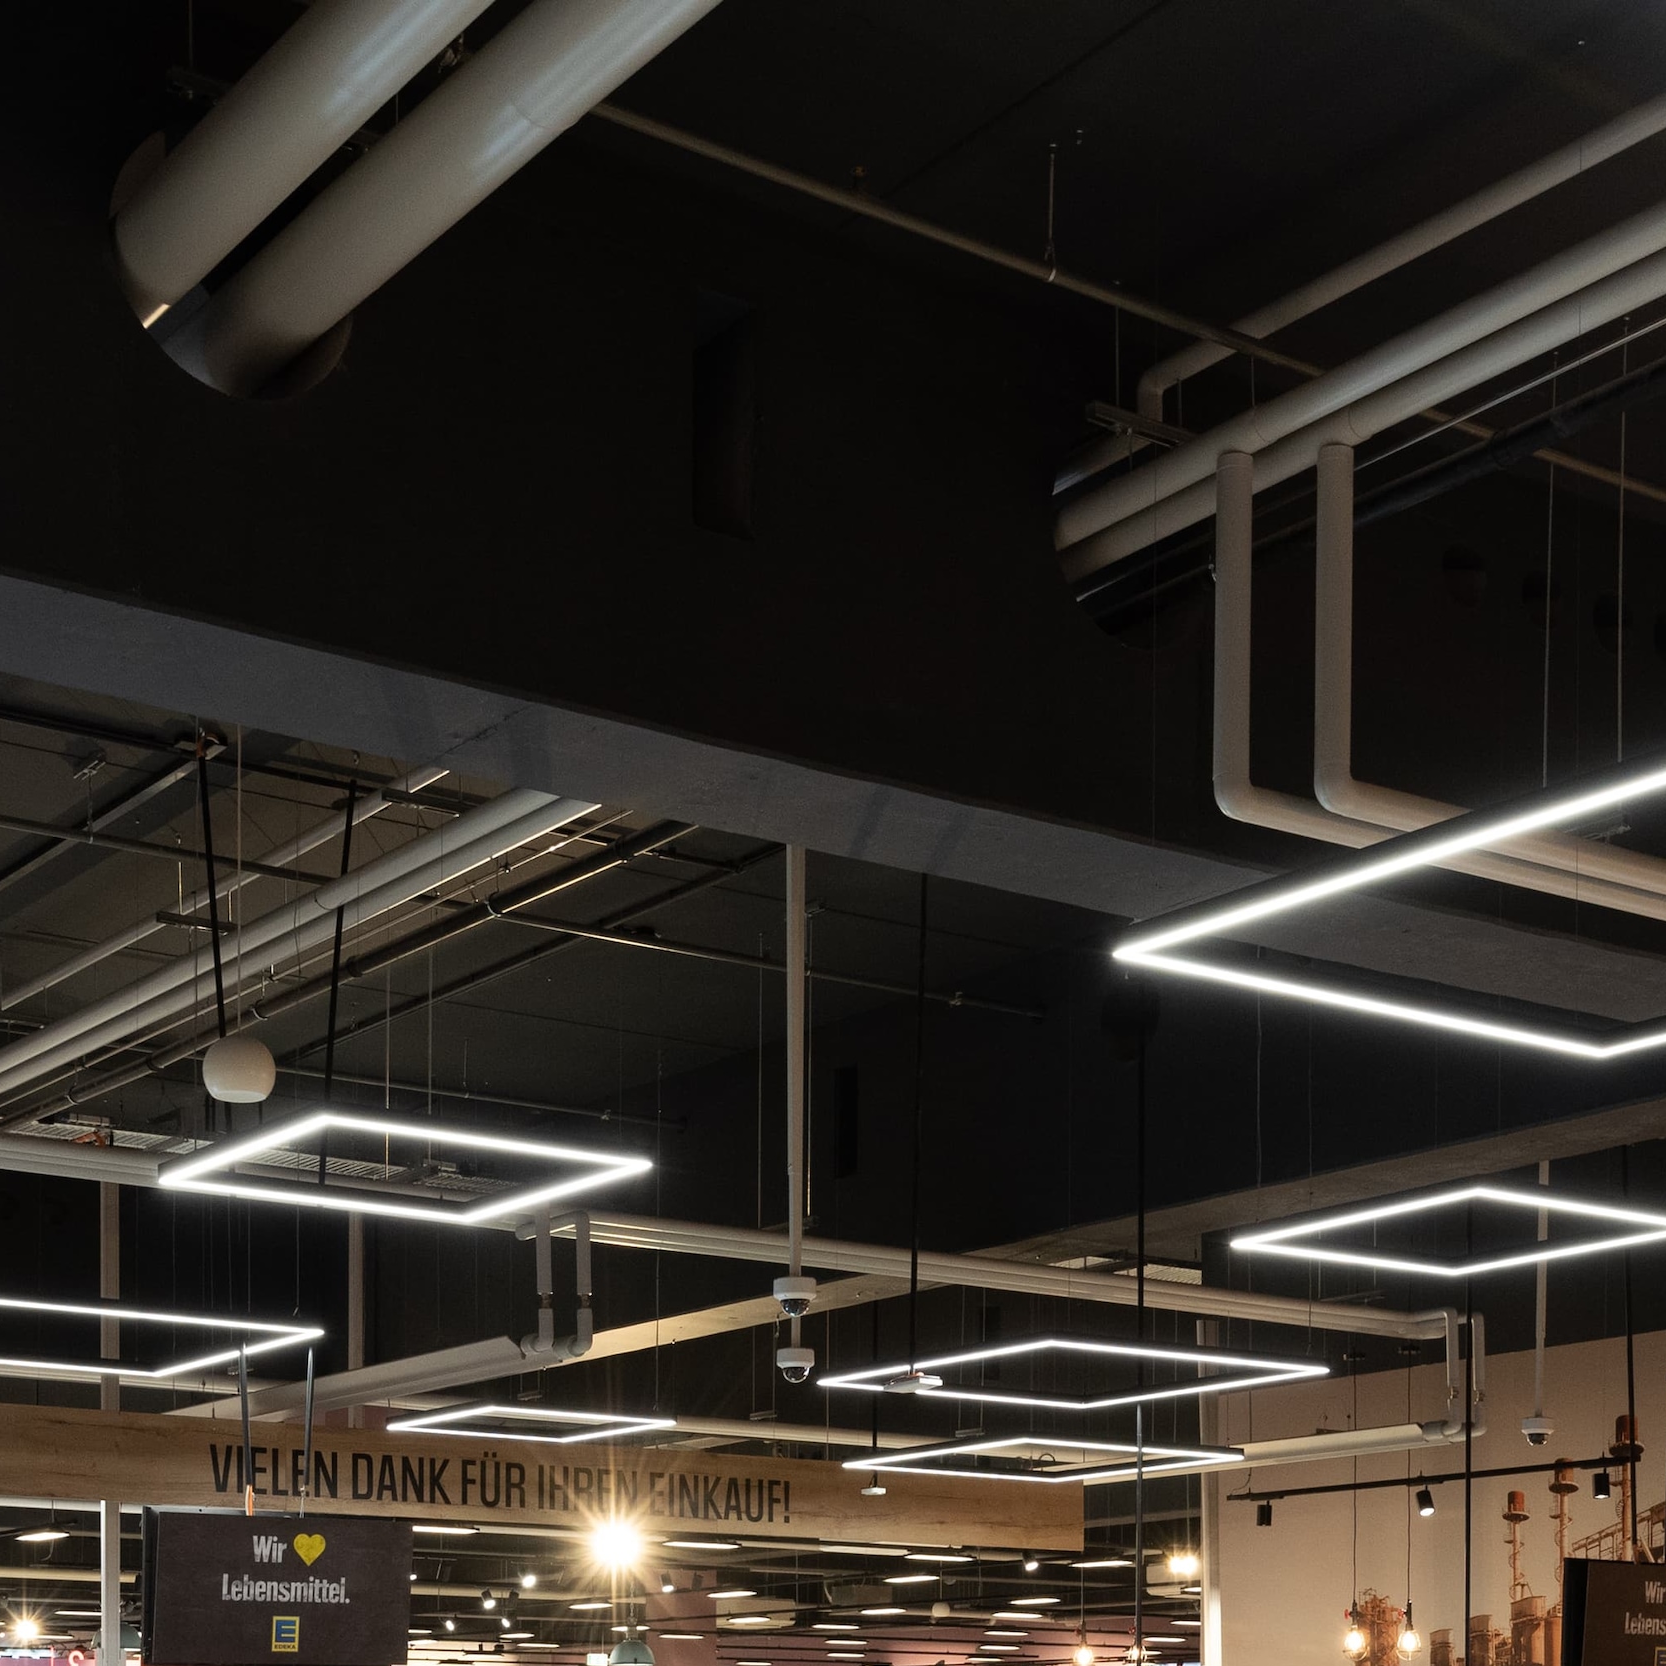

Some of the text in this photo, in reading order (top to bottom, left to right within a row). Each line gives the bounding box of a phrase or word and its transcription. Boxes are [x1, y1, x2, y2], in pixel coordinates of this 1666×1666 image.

[210, 1444, 791, 1524] VIELEN DANK FÜR IHREN EINKAUF!
[253, 1535, 287, 1563] Wir
[222, 1573, 350, 1604] Lebensmittel.
[1645, 1581, 1666, 1604] Wir
